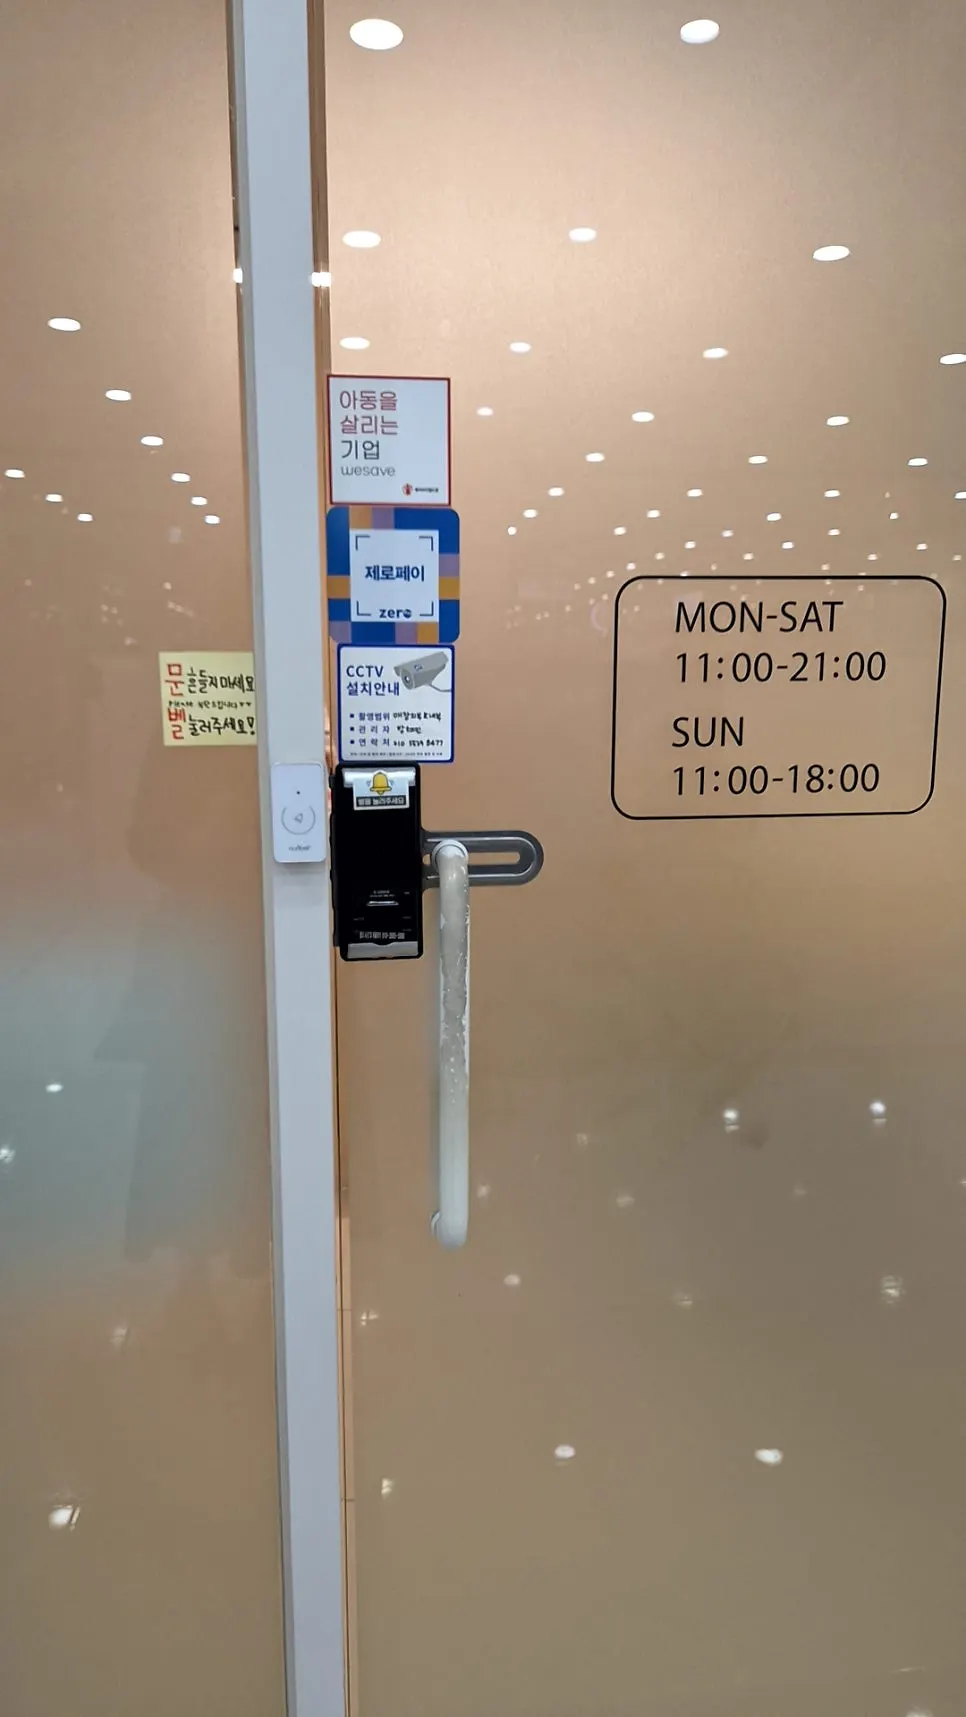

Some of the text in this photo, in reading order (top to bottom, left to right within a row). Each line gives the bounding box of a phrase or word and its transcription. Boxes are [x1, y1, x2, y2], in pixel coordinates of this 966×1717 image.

[340, 390, 398, 411] 아동을
[340, 414, 399, 435] 살리는
[341, 440, 380, 460] 기업
[341, 465, 396, 477] wesave
[365, 565, 425, 582] 제로페이
[675, 600, 844, 633] MON-SAT
[346, 665, 384, 678] CCTV
[676, 651, 887, 683] 11:00-21:00
[165, 664, 255, 697] 문 흔들지마세요
[346, 681, 400, 697] 설치안내
[168, 708, 256, 740] 벨 눌러주세요!
[671, 716, 744, 748] SUN
[673, 763, 880, 796] 11:00-18:00
